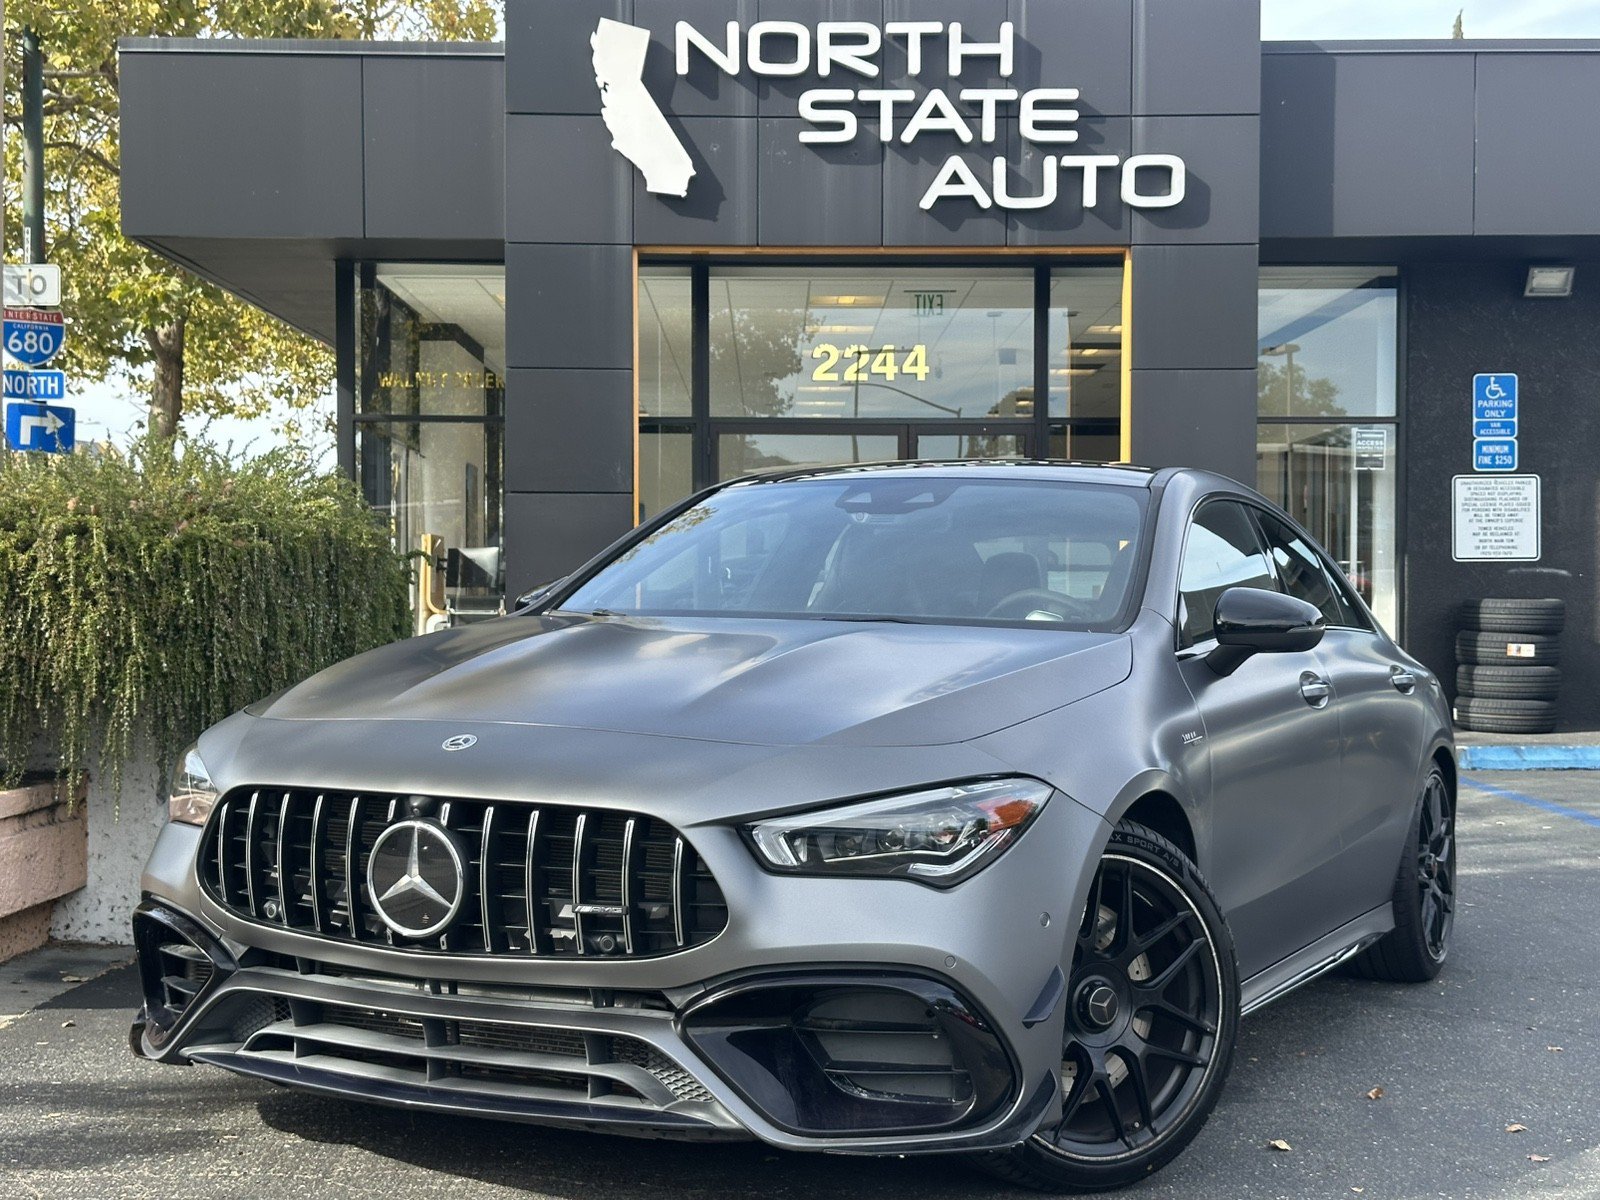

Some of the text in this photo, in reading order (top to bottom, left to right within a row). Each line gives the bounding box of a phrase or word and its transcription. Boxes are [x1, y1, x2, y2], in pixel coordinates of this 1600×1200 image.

[675, 21, 1013, 77] NORTH
[799, 88, 1079, 143] STATE
[919, 154, 1186, 209] AUTO
[12, 275, 47, 295] TO
[3, 310, 58, 322] INTERSTATE
[13, 323, 49, 331] CALIFORNIA
[8, 331, 53, 355] 680
[812, 343, 930, 381] 2244
[3, 374, 58, 395] NORTH
[1477, 400, 1513, 408] PARKING
[1482, 445, 1509, 454] MINIMUM
[1478, 455, 1512, 465] FINE $250
[1127, 836, 1160, 853] SPORT
